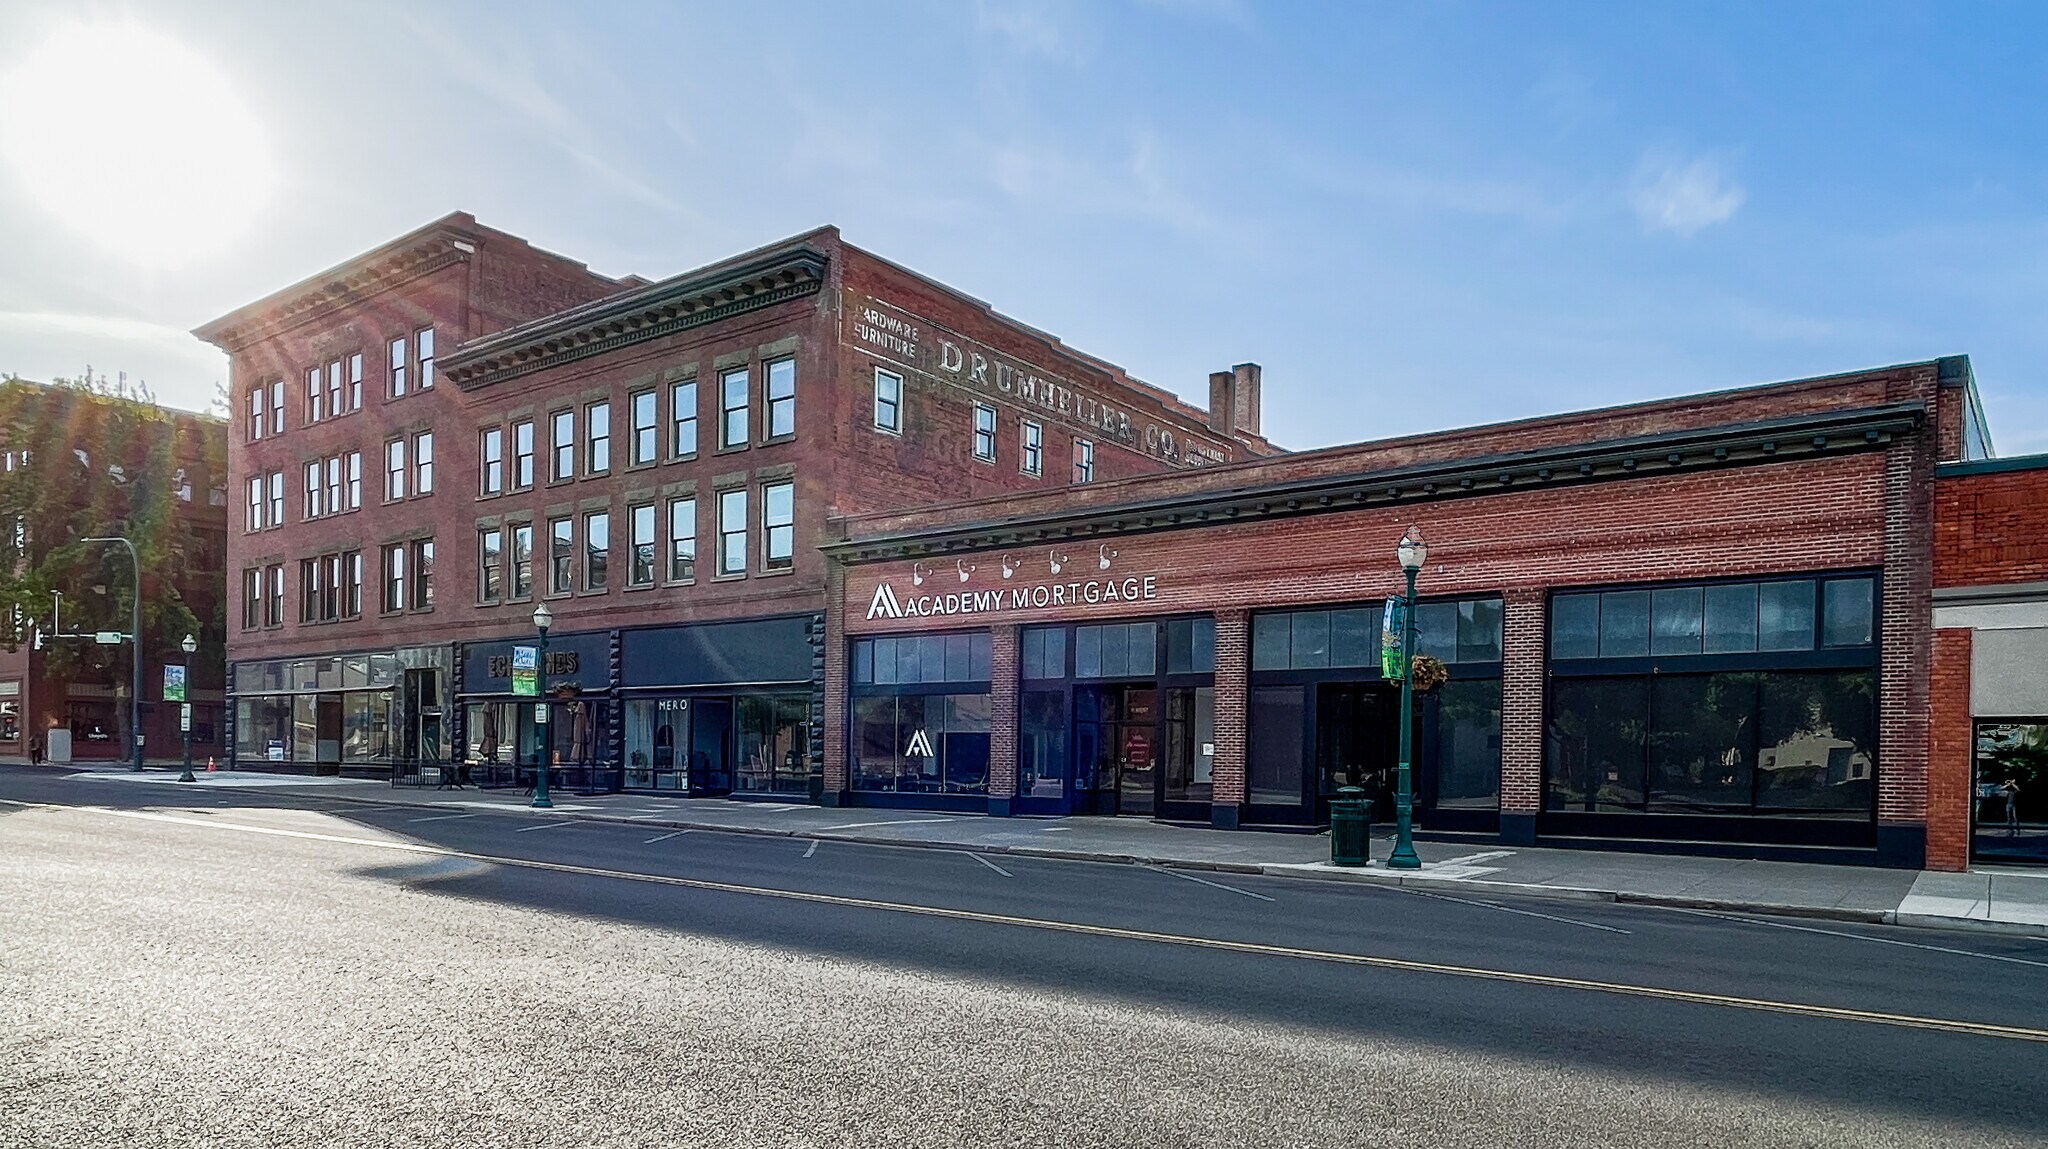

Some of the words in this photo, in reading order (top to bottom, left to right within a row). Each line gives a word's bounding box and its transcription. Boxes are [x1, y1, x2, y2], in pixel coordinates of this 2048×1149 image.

[936, 337, 1135, 441] DRUMHELLER
[1145, 423, 1179, 461] CO.
[904, 589, 1005, 618] ACADEMY
[1012, 576, 1157, 609] MORTGAGE
[658, 699, 688, 711] MERO
